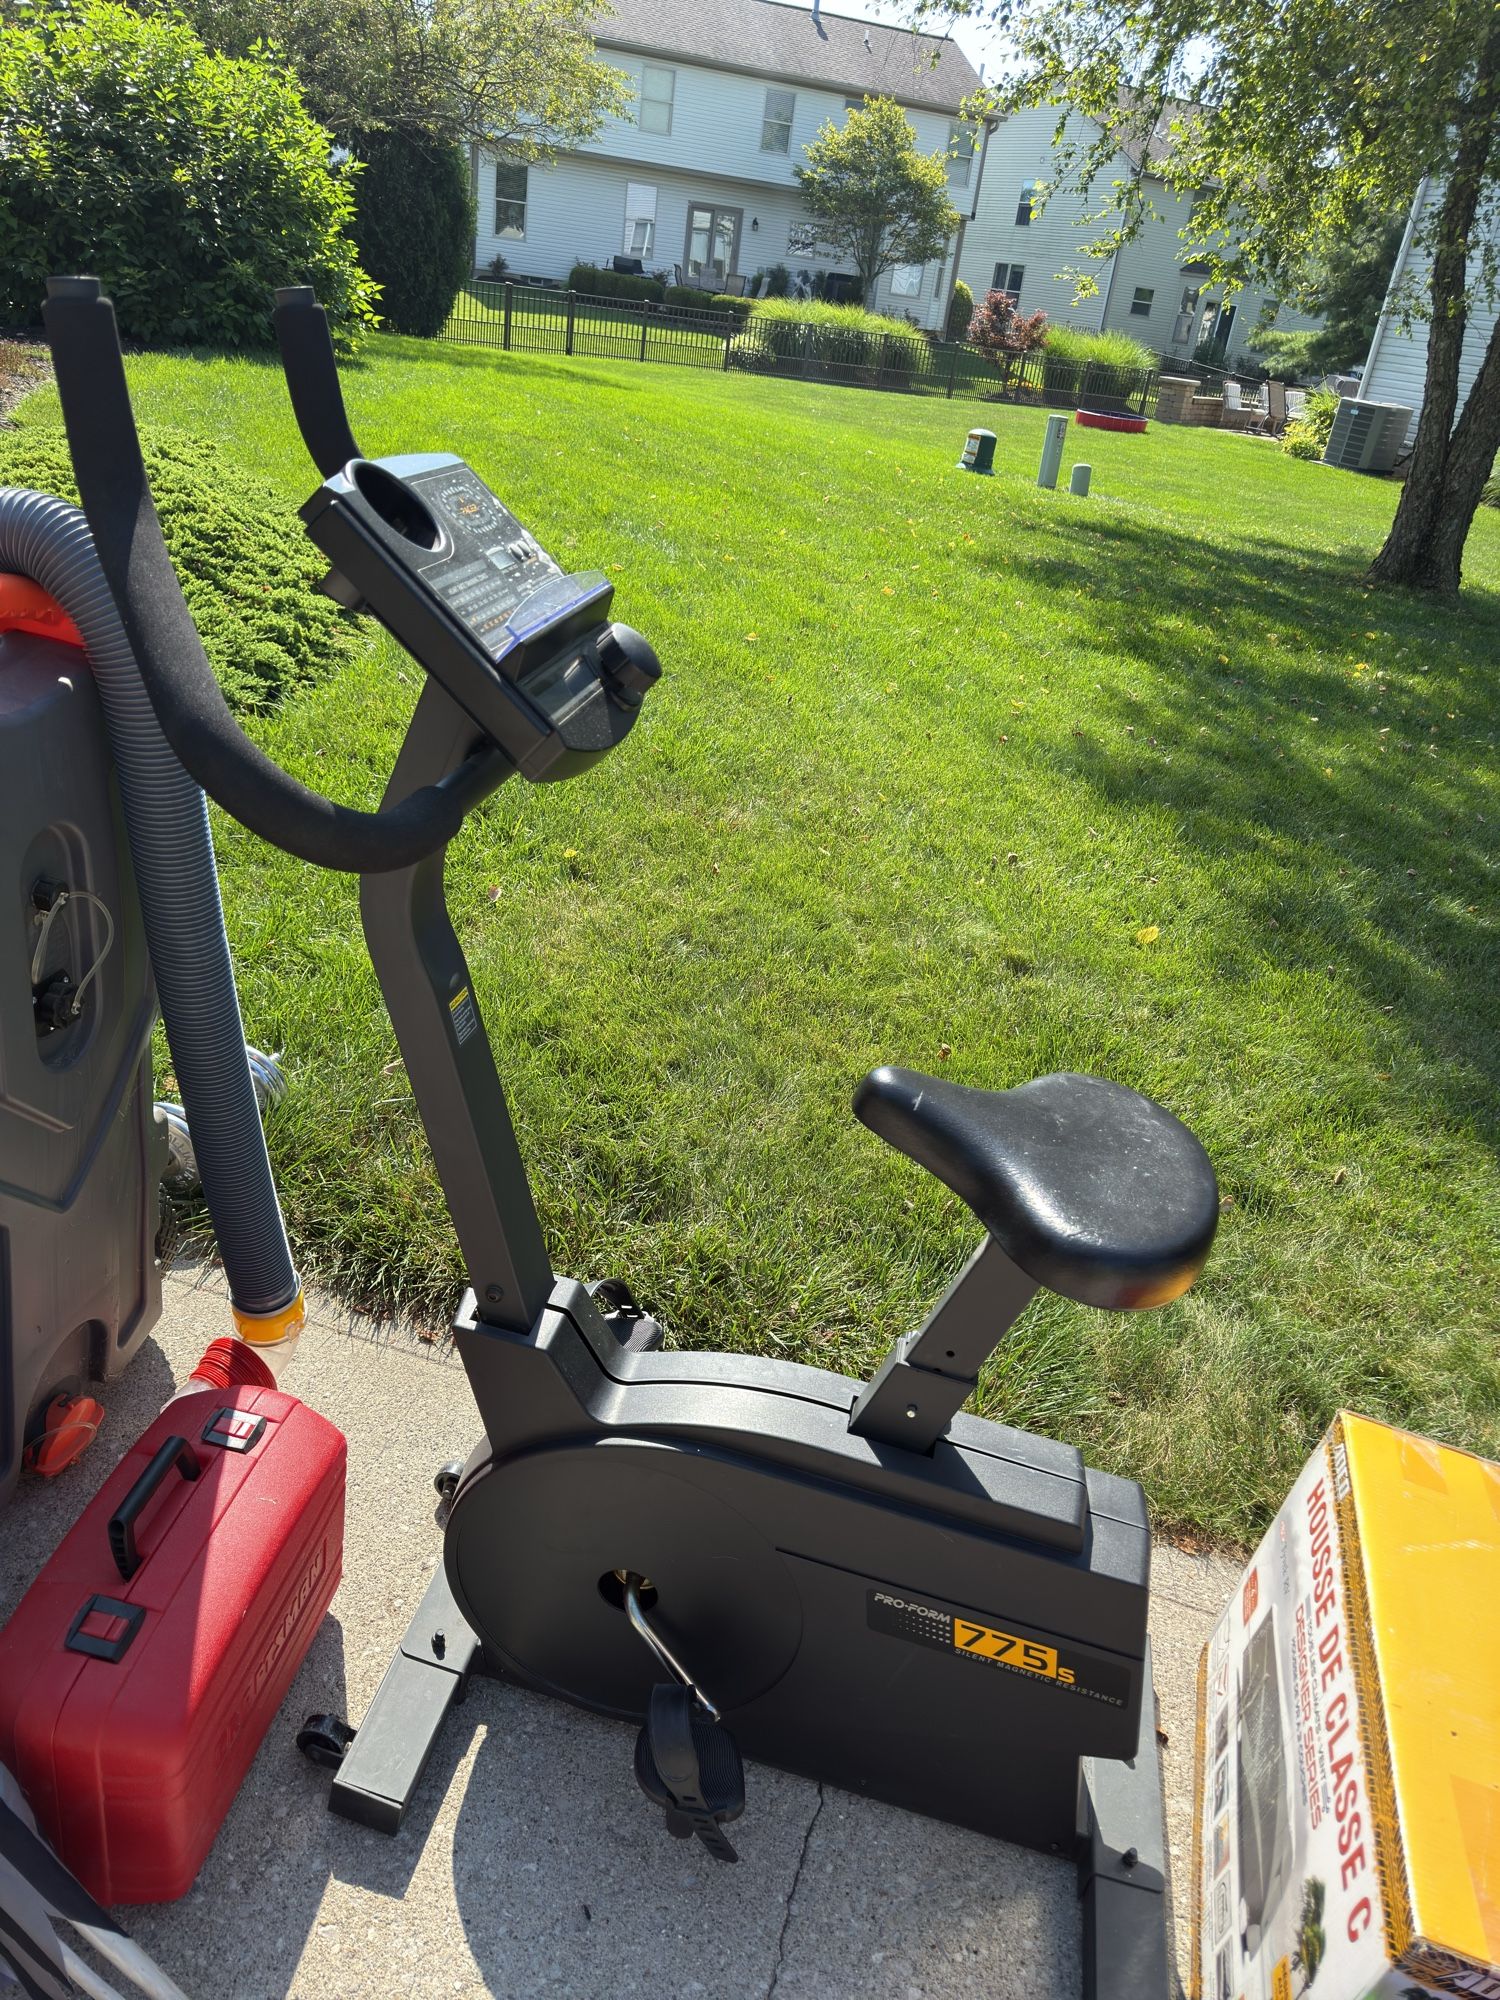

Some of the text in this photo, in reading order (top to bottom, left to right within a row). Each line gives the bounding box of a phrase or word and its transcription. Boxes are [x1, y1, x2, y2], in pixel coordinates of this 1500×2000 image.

[874, 1592, 951, 1624] PRO-FORM
[954, 1648, 1124, 1707] SILENT MAGNETIC RESISTANCE
[1296, 1602, 1323, 1831] DESIGNER SERIES
[1306, 1477, 1372, 1942] HOUSSE DE CLASSE C
